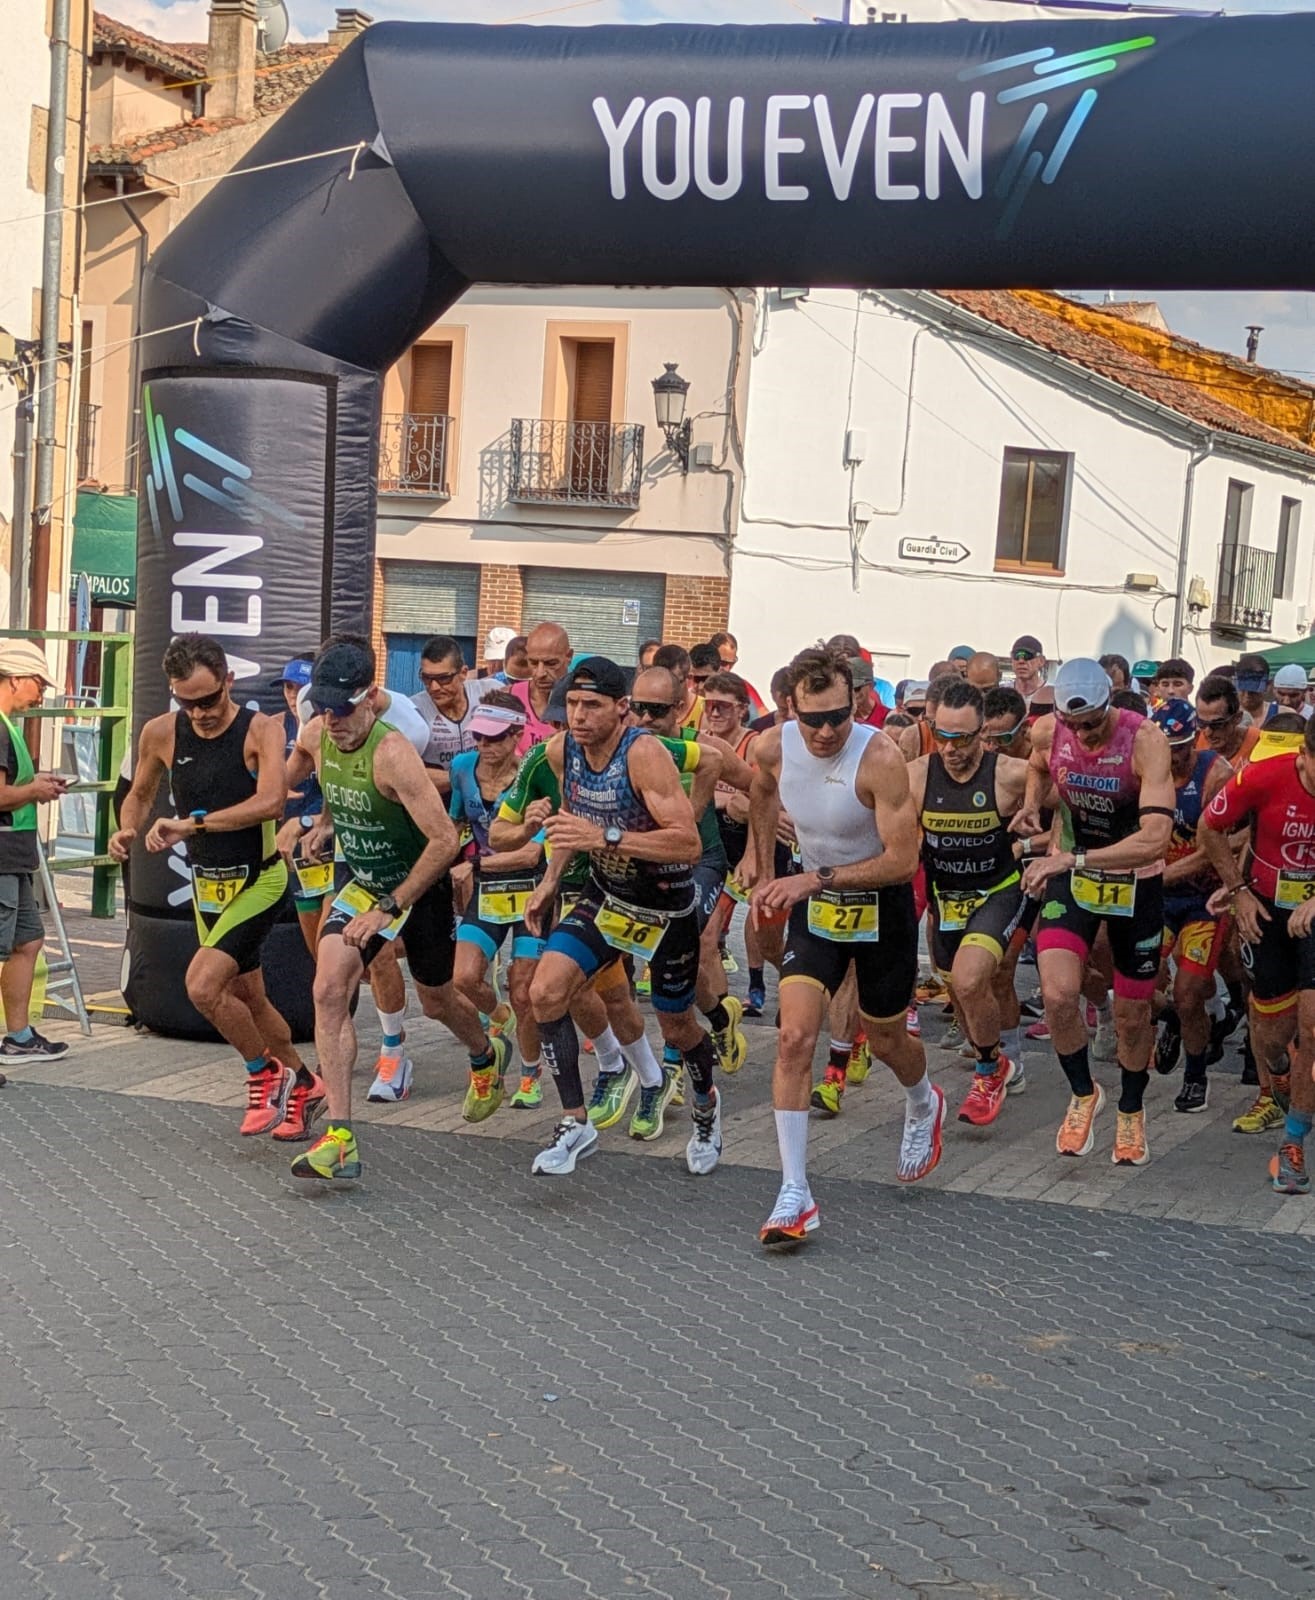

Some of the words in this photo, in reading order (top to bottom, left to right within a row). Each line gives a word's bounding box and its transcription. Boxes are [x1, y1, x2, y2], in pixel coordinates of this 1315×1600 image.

[592, 96, 744, 200] YOU
[764, 91, 986, 201] EVEN
[906, 543, 937, 555] Guardia
[939, 546, 958, 556] Civil
[1066, 772, 1119, 792] SALTOKI
[325, 782, 340, 805] DE
[340, 786, 372, 812] DIEGO
[927, 818, 991, 830] TRIOVIEDO
[941, 834, 995, 847] OVIEDO
[323, 865, 330, 883] 3
[933, 857, 996, 874] GONZÁLEZ
[215, 881, 237, 902] 61
[1096, 885, 1120, 905] 11
[507, 894, 516, 913] 1
[833, 908, 864, 930] 27
[622, 921, 651, 944] 16
